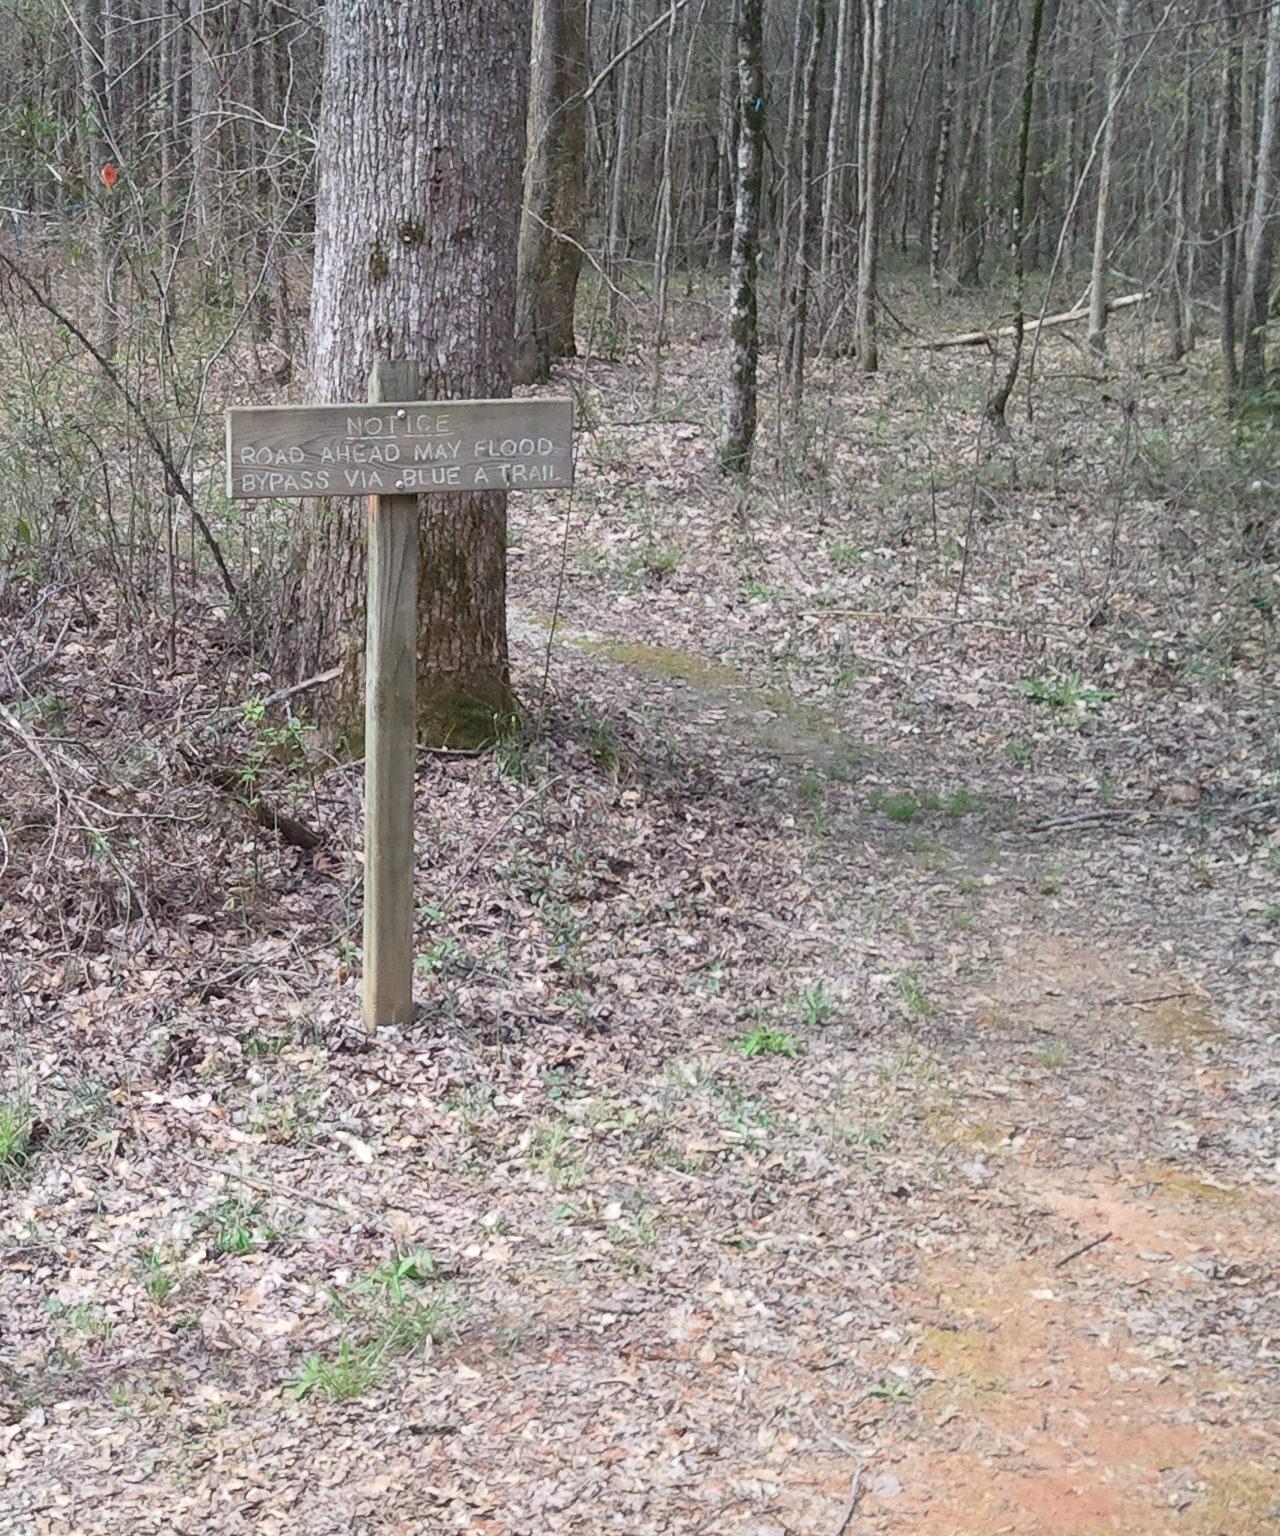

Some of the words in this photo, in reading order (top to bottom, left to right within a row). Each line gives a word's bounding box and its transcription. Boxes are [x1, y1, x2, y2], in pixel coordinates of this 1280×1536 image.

[346, 414, 451, 436] NOTICE
[240, 446, 305, 465] ROAD
[320, 443, 401, 463] AHEAD
[414, 441, 462, 462] MAY
[241, 470, 331, 493] BYPASS
[344, 469, 384, 488] VIA
[402, 466, 461, 487] BLUE
[473, 467, 489, 484] A
